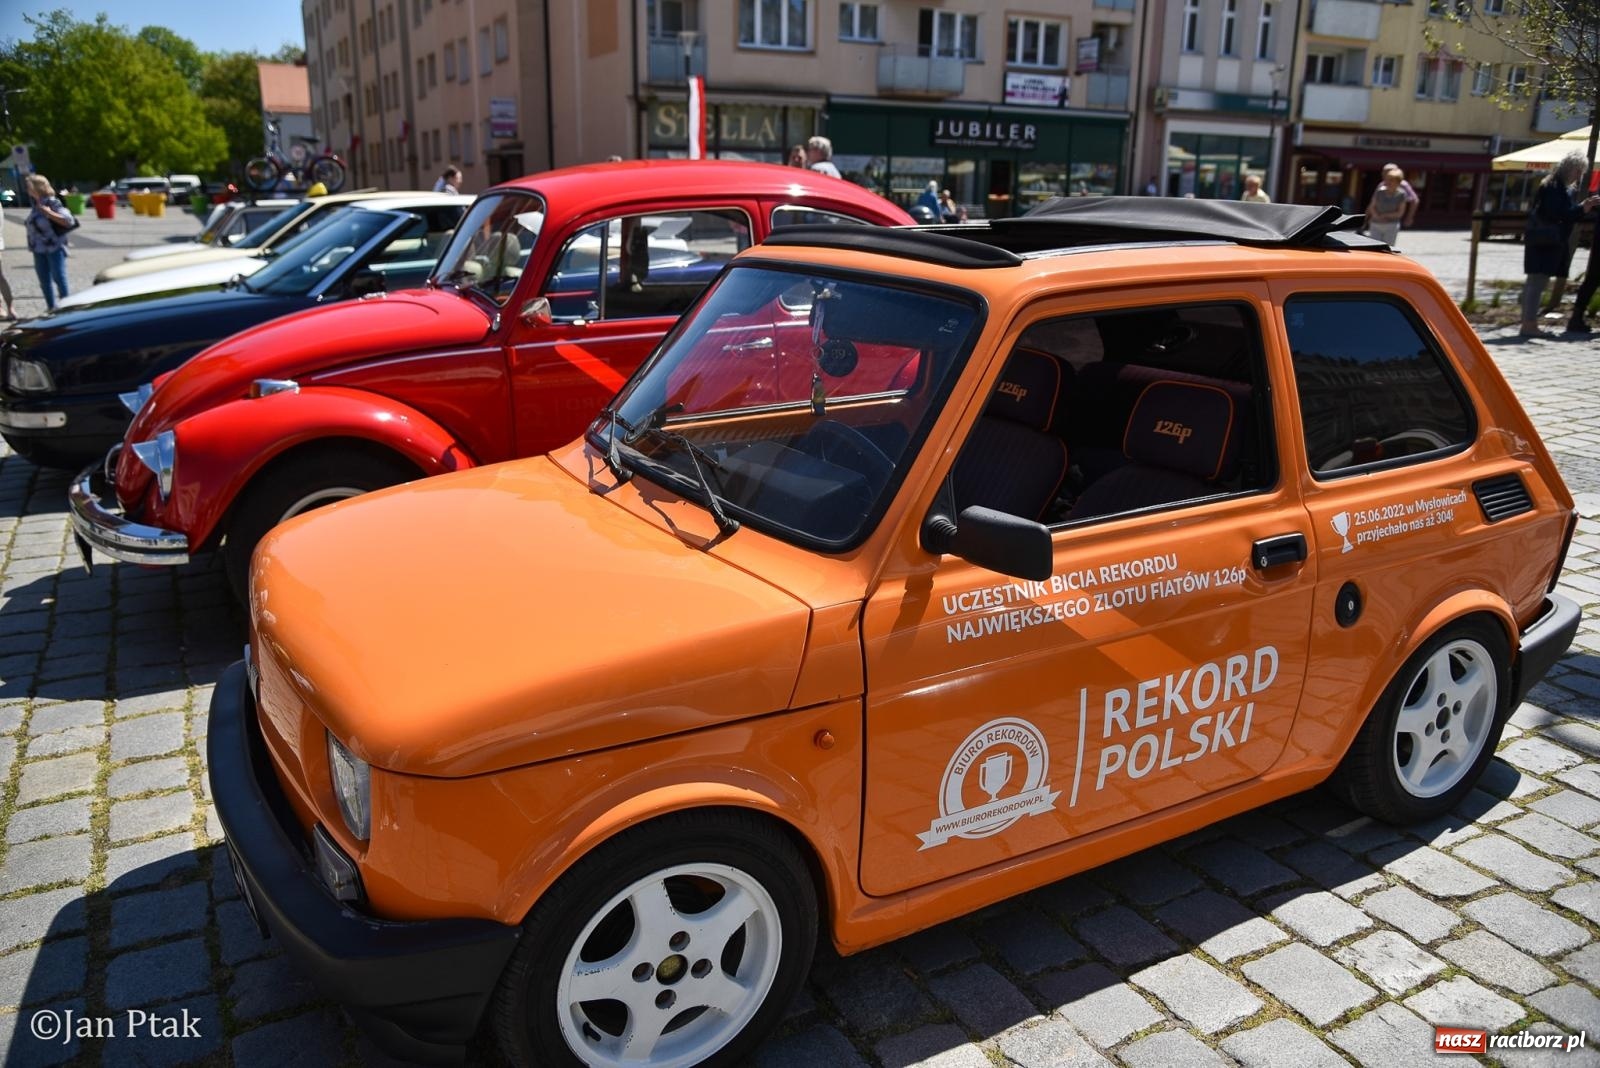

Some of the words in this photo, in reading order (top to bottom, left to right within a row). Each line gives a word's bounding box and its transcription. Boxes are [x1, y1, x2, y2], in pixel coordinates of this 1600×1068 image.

[935, 119, 1037, 140] JUBILER
[1152, 419, 1193, 444] 126p
[1354, 503, 1405, 526] 25.06.2022
[1406, 503, 1414, 515] w
[1415, 490, 1466, 513] Mysłowicach
[1357, 521, 1408, 545] przyjechało
[1409, 518, 1425, 532] nas
[1425, 515, 1435, 528] aż
[1436, 508, 1454, 523] 304!
[942, 579, 1048, 615] UCZESTNIK
[1050, 568, 1098, 594] BICIA
[1099, 552, 1178, 584] REKORDU
[946, 597, 1091, 644] NAJWIĘKSZEGO
[1093, 584, 1147, 613] ZLOTU
[1149, 570, 1211, 600] FIATÓW
[1213, 565, 1247, 587] 126p
[1102, 645, 1280, 739] REKORD
[954, 739, 984, 777] BIURO
[986, 728, 1040, 760] REKORDÓW
[1095, 702, 1255, 791] POLSKI
